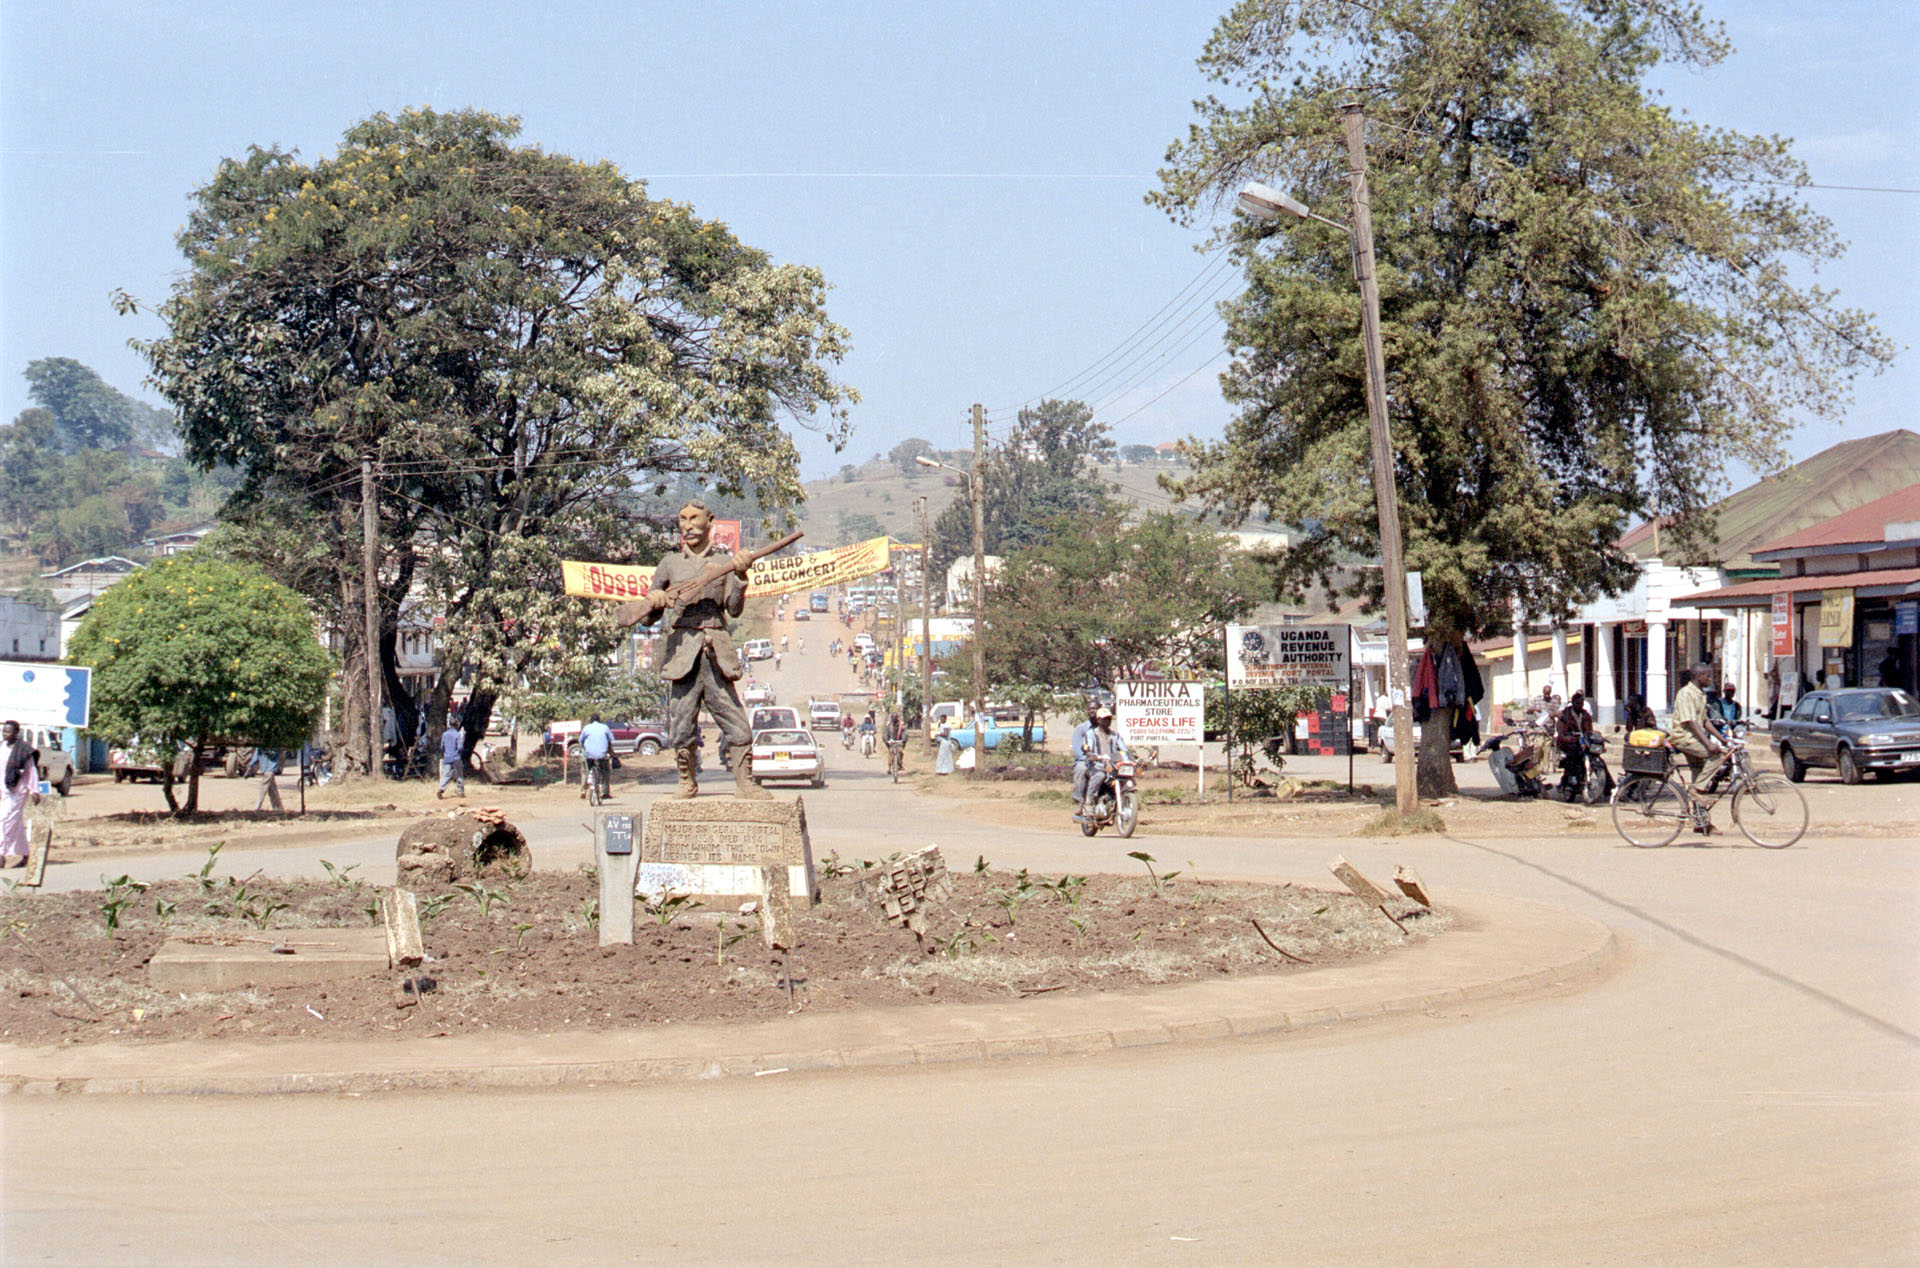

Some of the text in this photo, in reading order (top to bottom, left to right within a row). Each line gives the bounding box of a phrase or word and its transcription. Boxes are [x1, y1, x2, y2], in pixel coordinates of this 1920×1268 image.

[770, 556, 803, 571] HEAD
[809, 554, 817, 564] &
[781, 562, 836, 582] CONCERT
[594, 566, 655, 597] Obses
[1281, 631, 1329, 641] UGANDA
[1281, 641, 1336, 652] REVENUE
[1245, 663, 1287, 671] DEPARTMENT
[1127, 682, 1190, 697] VIRIKA
[1118, 698, 1200, 707] PHARMACEUTICALS
[1145, 707, 1173, 716] STORE
[1125, 717, 1196, 728] SPEAKS LIFE
[607, 820, 619, 828] AV
[664, 824, 692, 833] MAJOR
[664, 843, 780, 853] FROM WHOM THIS TOWN
[708, 853, 722, 861] ITS
